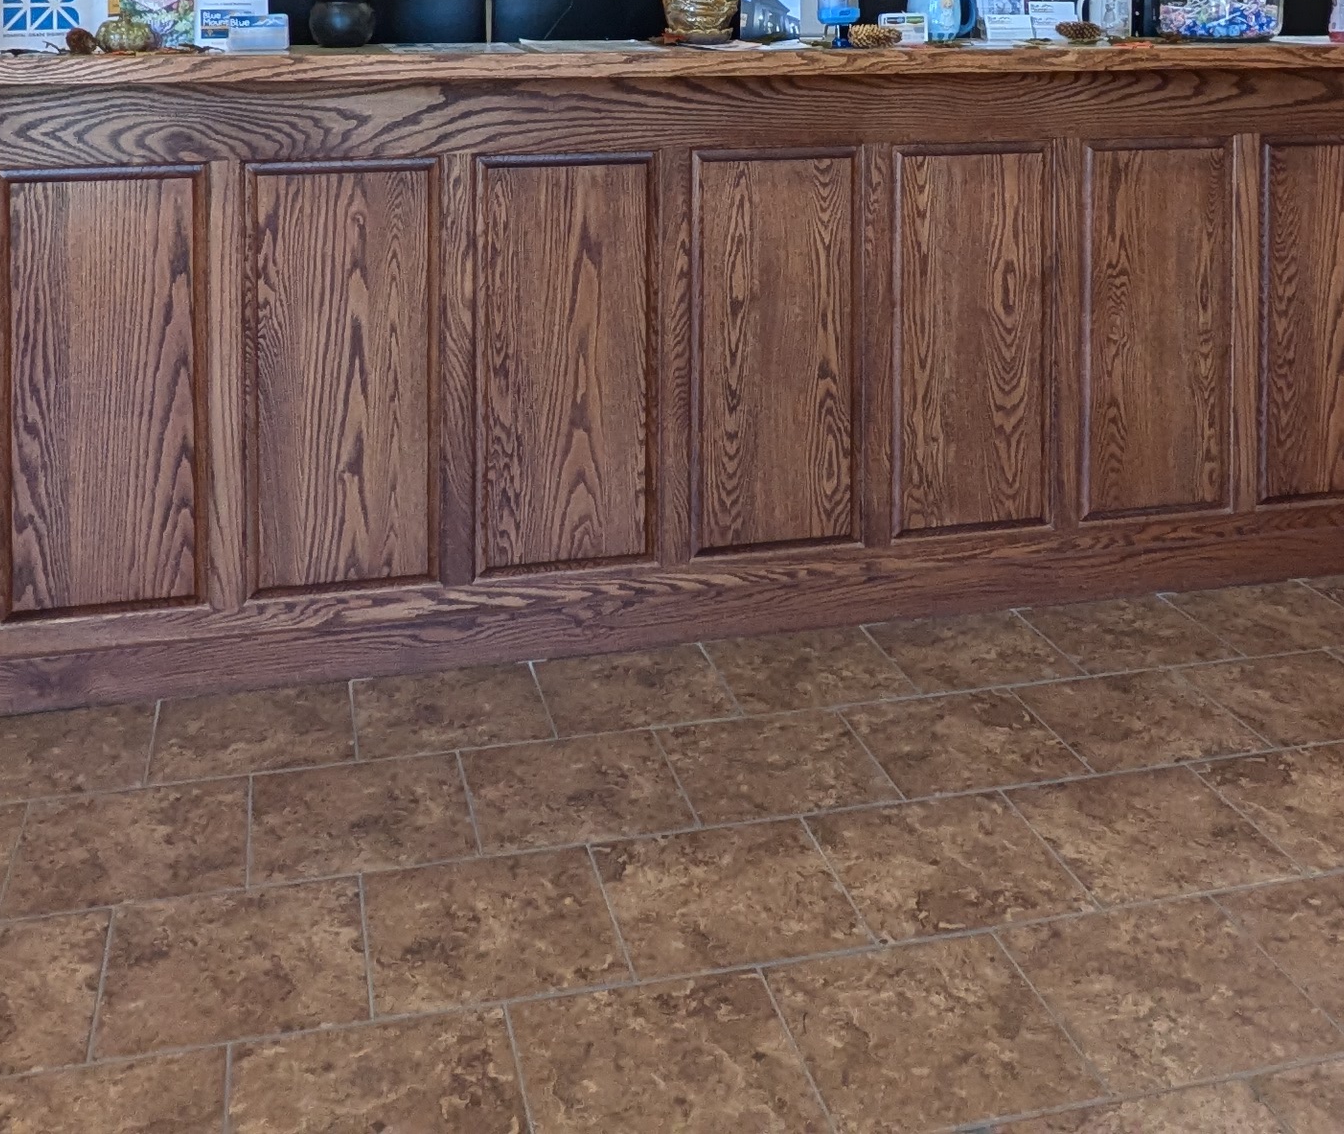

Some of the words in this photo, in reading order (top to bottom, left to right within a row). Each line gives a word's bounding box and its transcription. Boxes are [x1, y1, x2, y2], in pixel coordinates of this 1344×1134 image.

[202, 11, 222, 20] Blue
[202, 19, 229, 27] Mount
[230, 18, 251, 27] Blue
